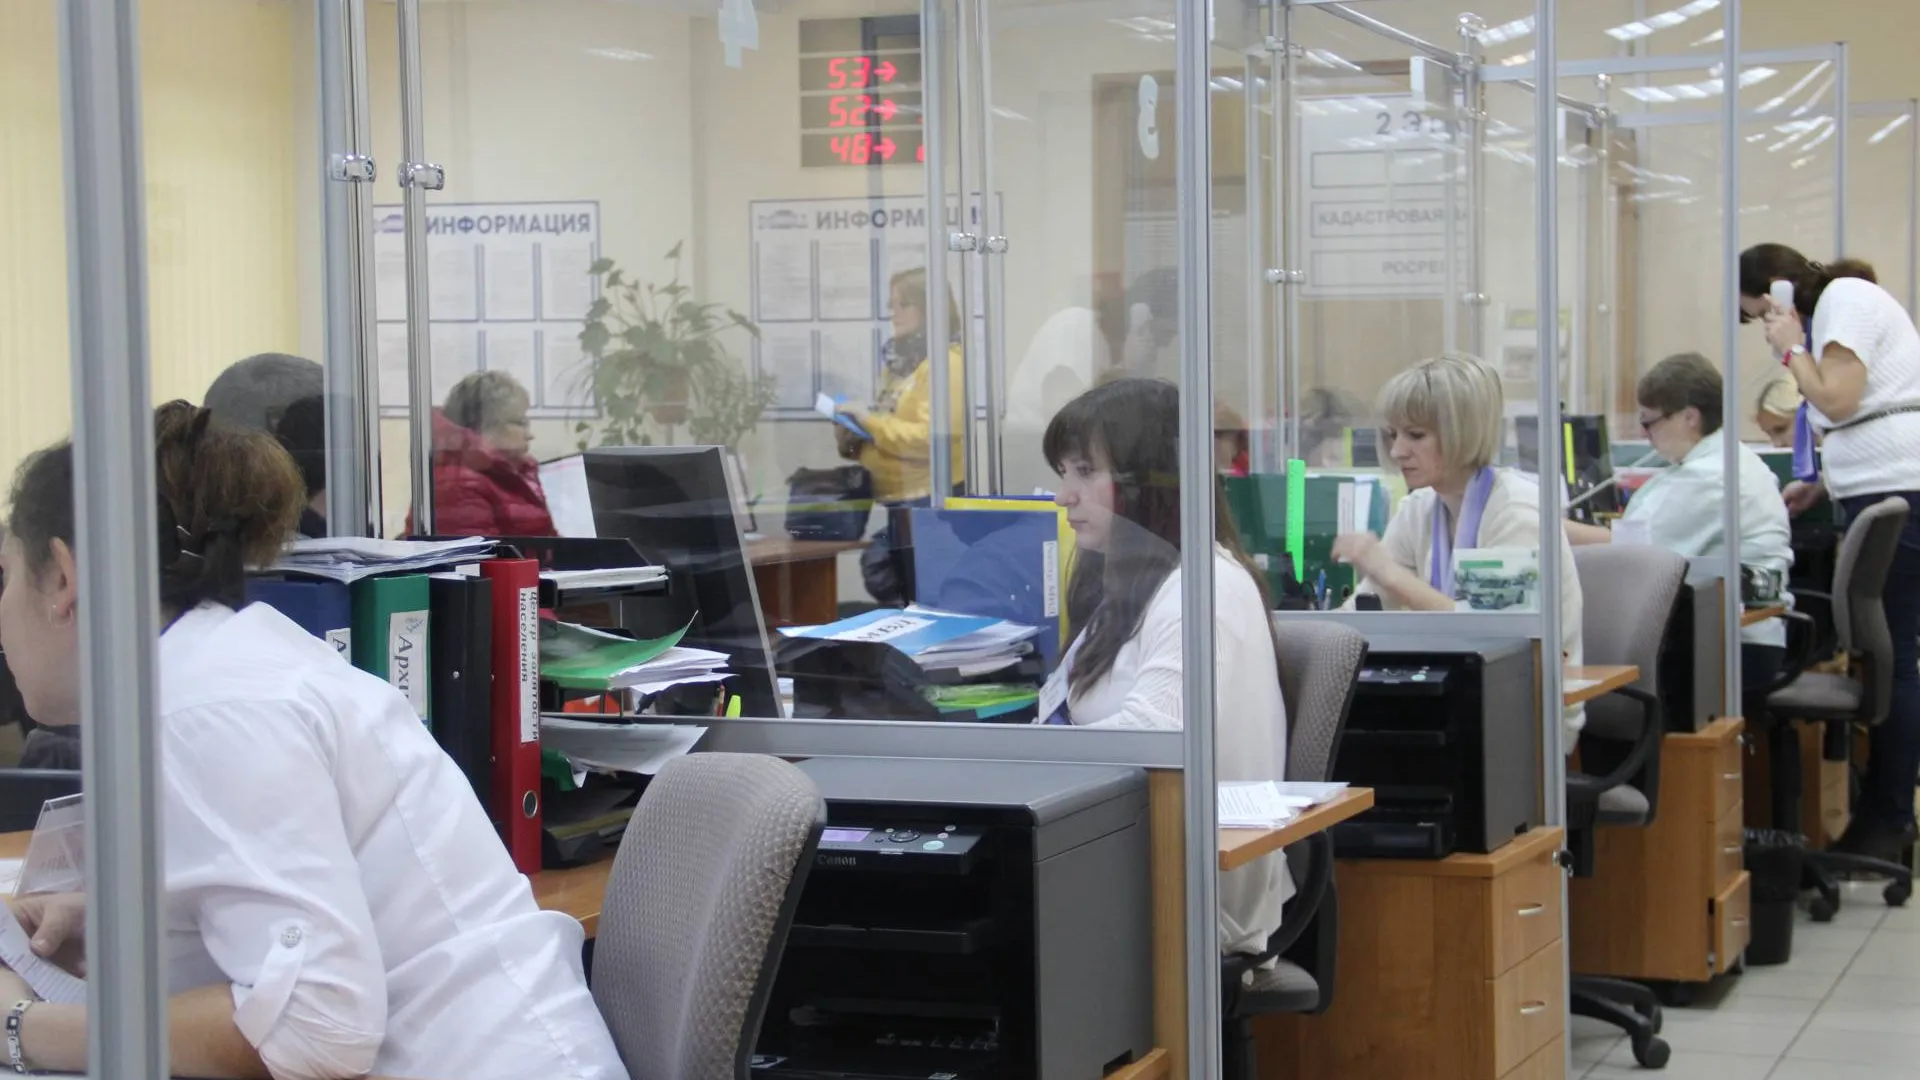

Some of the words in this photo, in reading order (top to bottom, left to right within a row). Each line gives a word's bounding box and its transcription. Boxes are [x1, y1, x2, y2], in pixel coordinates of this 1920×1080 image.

[827, 56, 871, 89] 53
[828, 95, 872, 127] 52
[830, 133, 872, 165] 48
[427, 213, 591, 235] ИНФОРМАЦИЯ
[520, 592, 528, 682] населения
[817, 854, 856, 866] Canon
